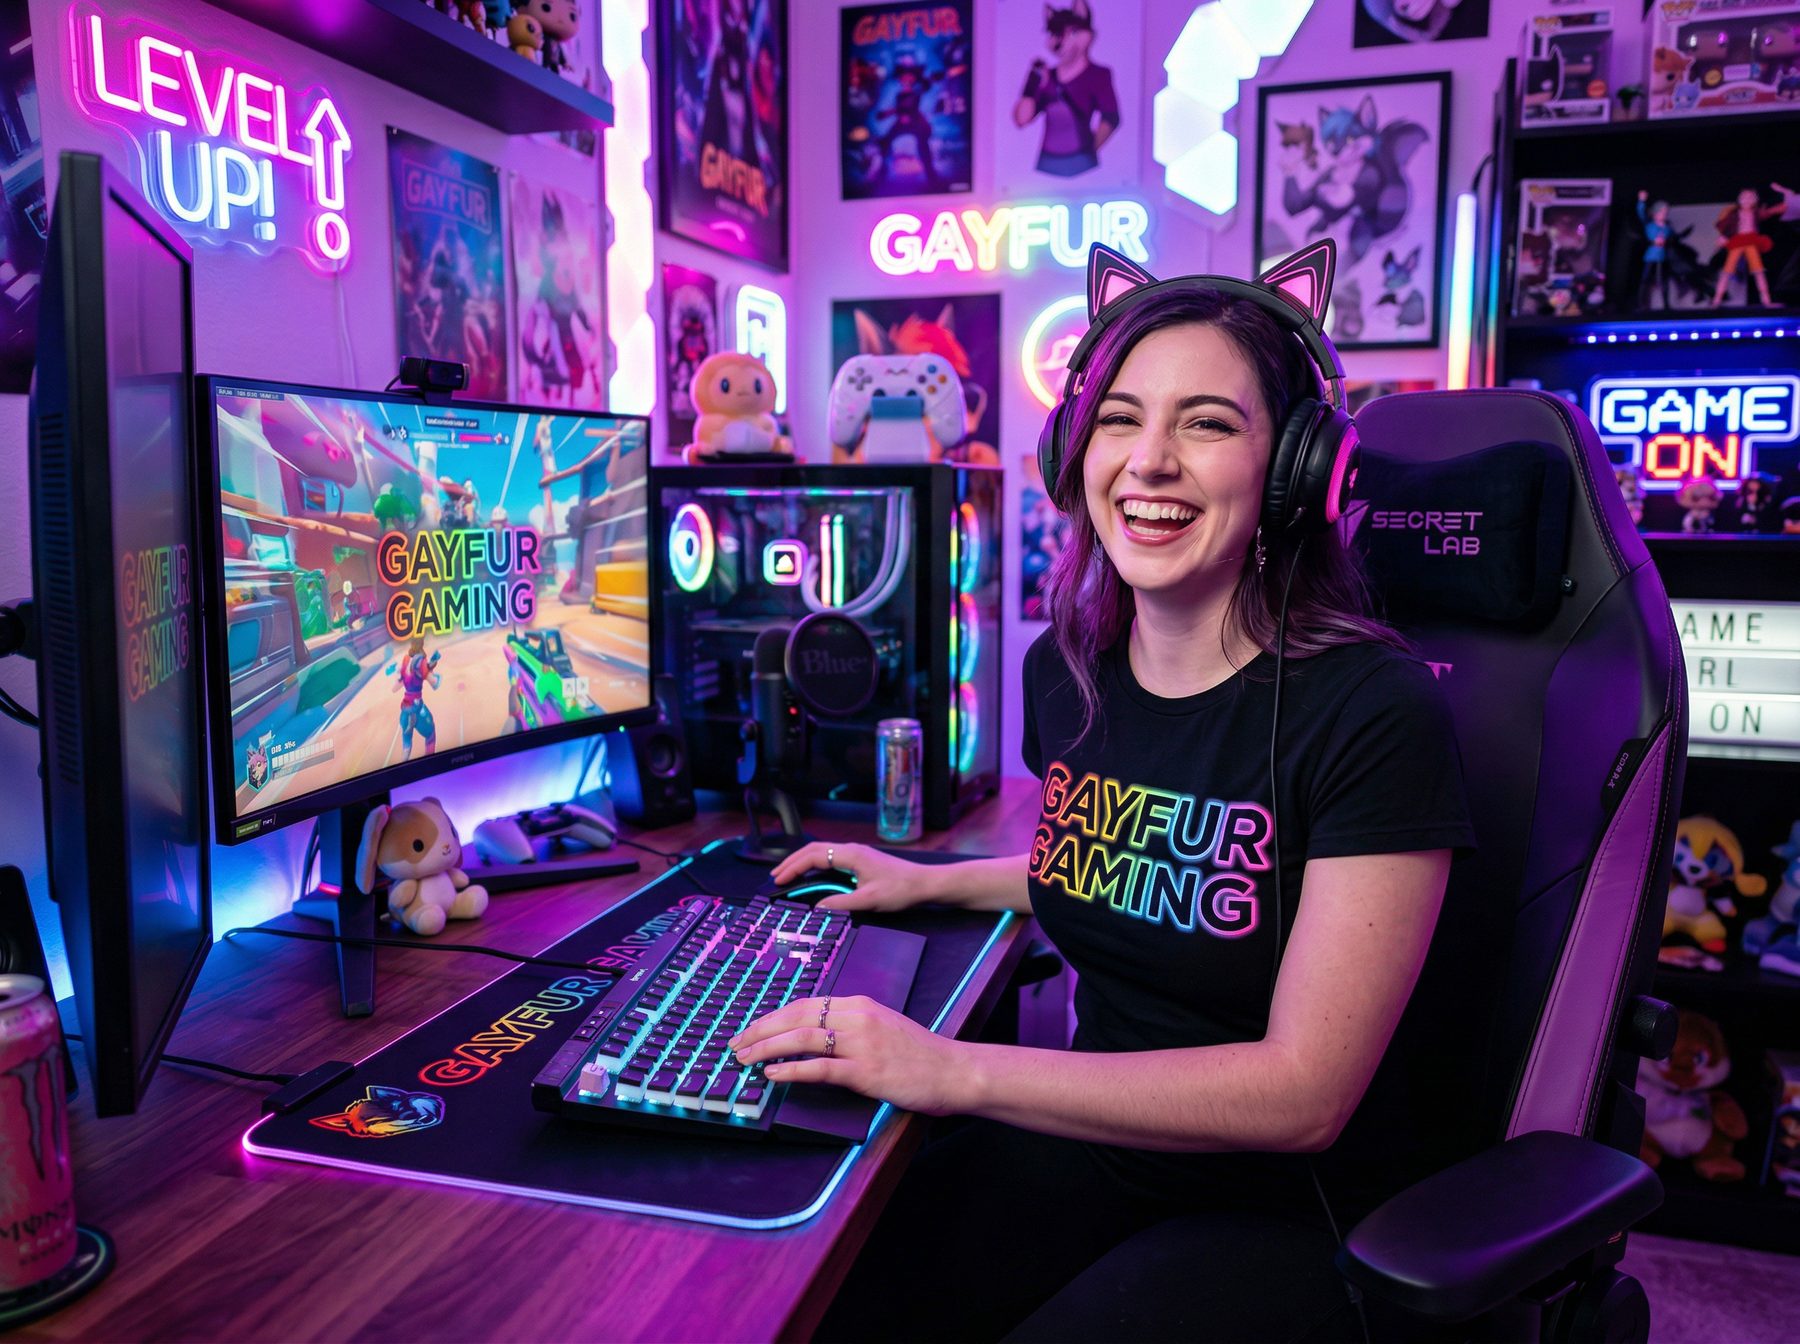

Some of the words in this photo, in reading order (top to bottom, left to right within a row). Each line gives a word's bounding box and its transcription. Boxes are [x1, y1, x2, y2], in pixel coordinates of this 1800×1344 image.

[853, 7, 963, 45] GAYFUR
[91, 14, 315, 167] LEVEL
[158, 129, 277, 240] UP!
[407, 170, 488, 227] GAYFUR
[701, 141, 769, 218] GAYFUR
[869, 200, 1150, 275] GAYFUR
[1602, 386, 1790, 434] GAME
[1646, 434, 1739, 479] ON
[377, 525, 542, 587] GAYFUR
[1371, 511, 1484, 533] SECRET
[1424, 535, 1480, 555] LAB
[120, 543, 190, 628] GAYFUR
[385, 577, 538, 641] GAMING
[126, 611, 190, 702] GAMING
[1681, 611, 1764, 644] AME
[1041, 761, 1274, 871] GAYFUR
[1028, 825, 1259, 937] GAMING
[586, 894, 722, 975] GAM
[418, 975, 613, 1087] GAYFUR
